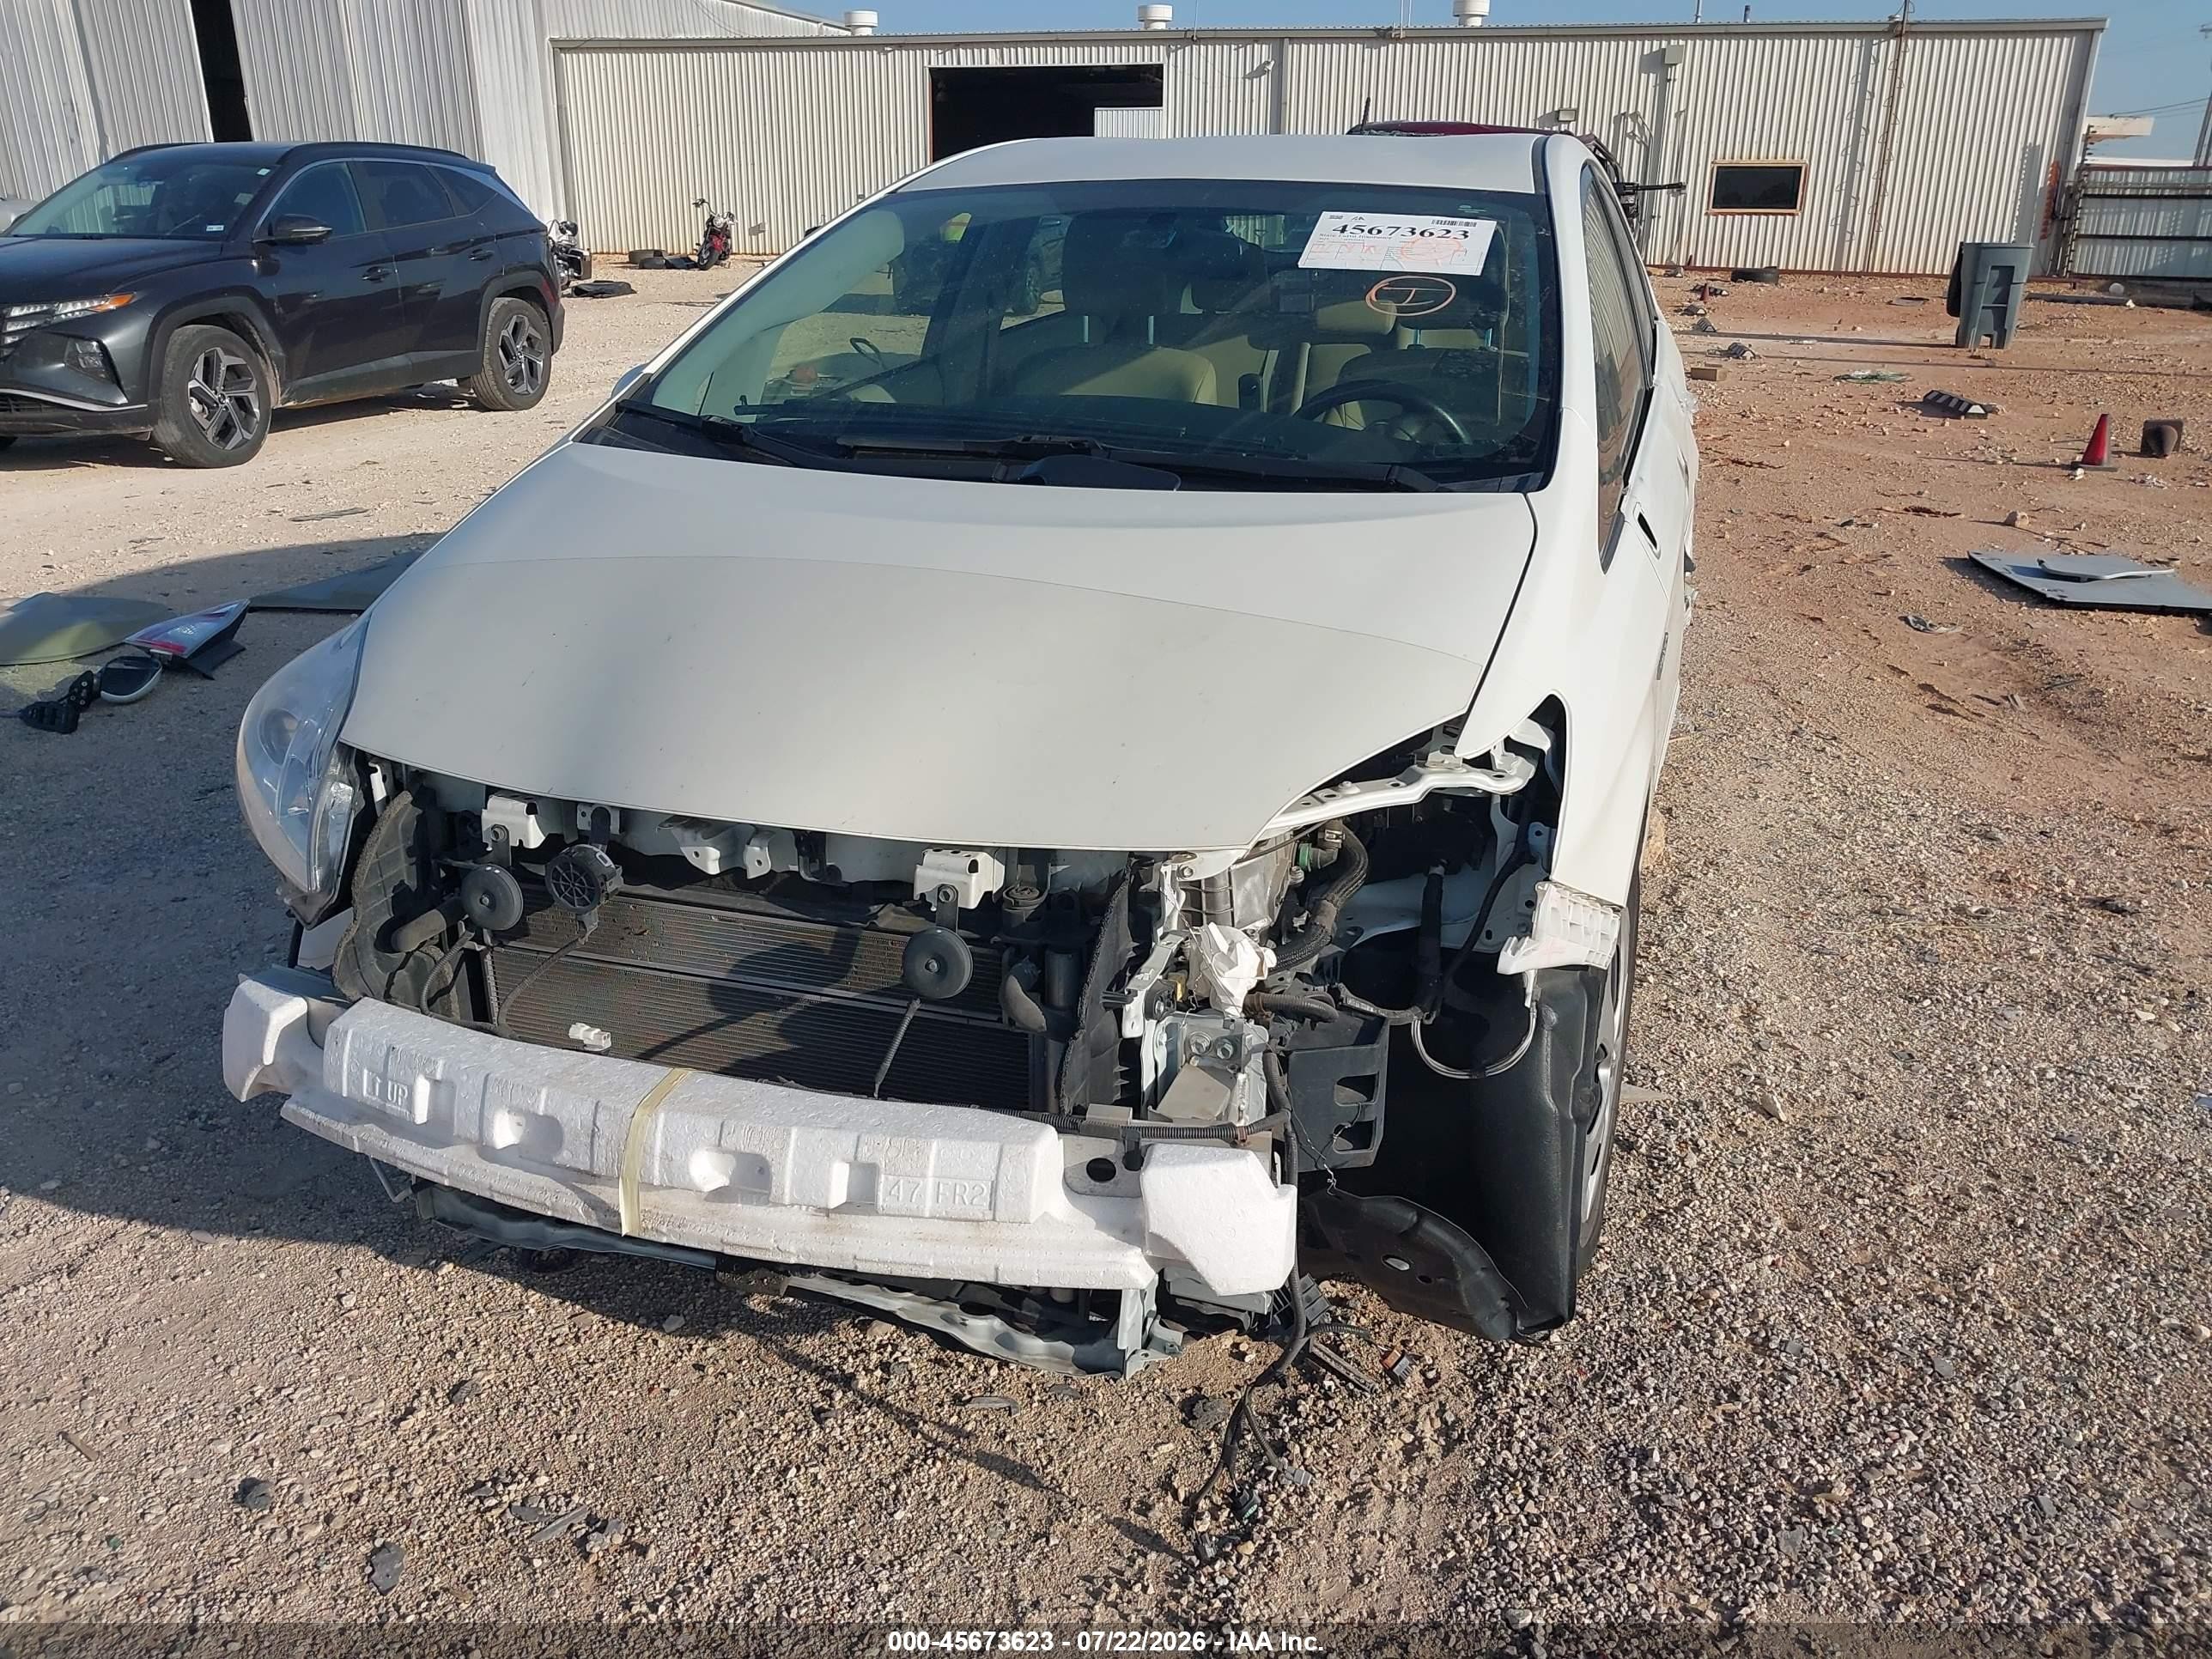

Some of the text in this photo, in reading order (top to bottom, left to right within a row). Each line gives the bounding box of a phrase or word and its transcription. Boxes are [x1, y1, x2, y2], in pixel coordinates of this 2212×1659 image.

[1332, 223, 1469, 240] 45673623
[387, 1079, 408, 1106] UP
[889, 1178, 988, 1206] 47 FR2
